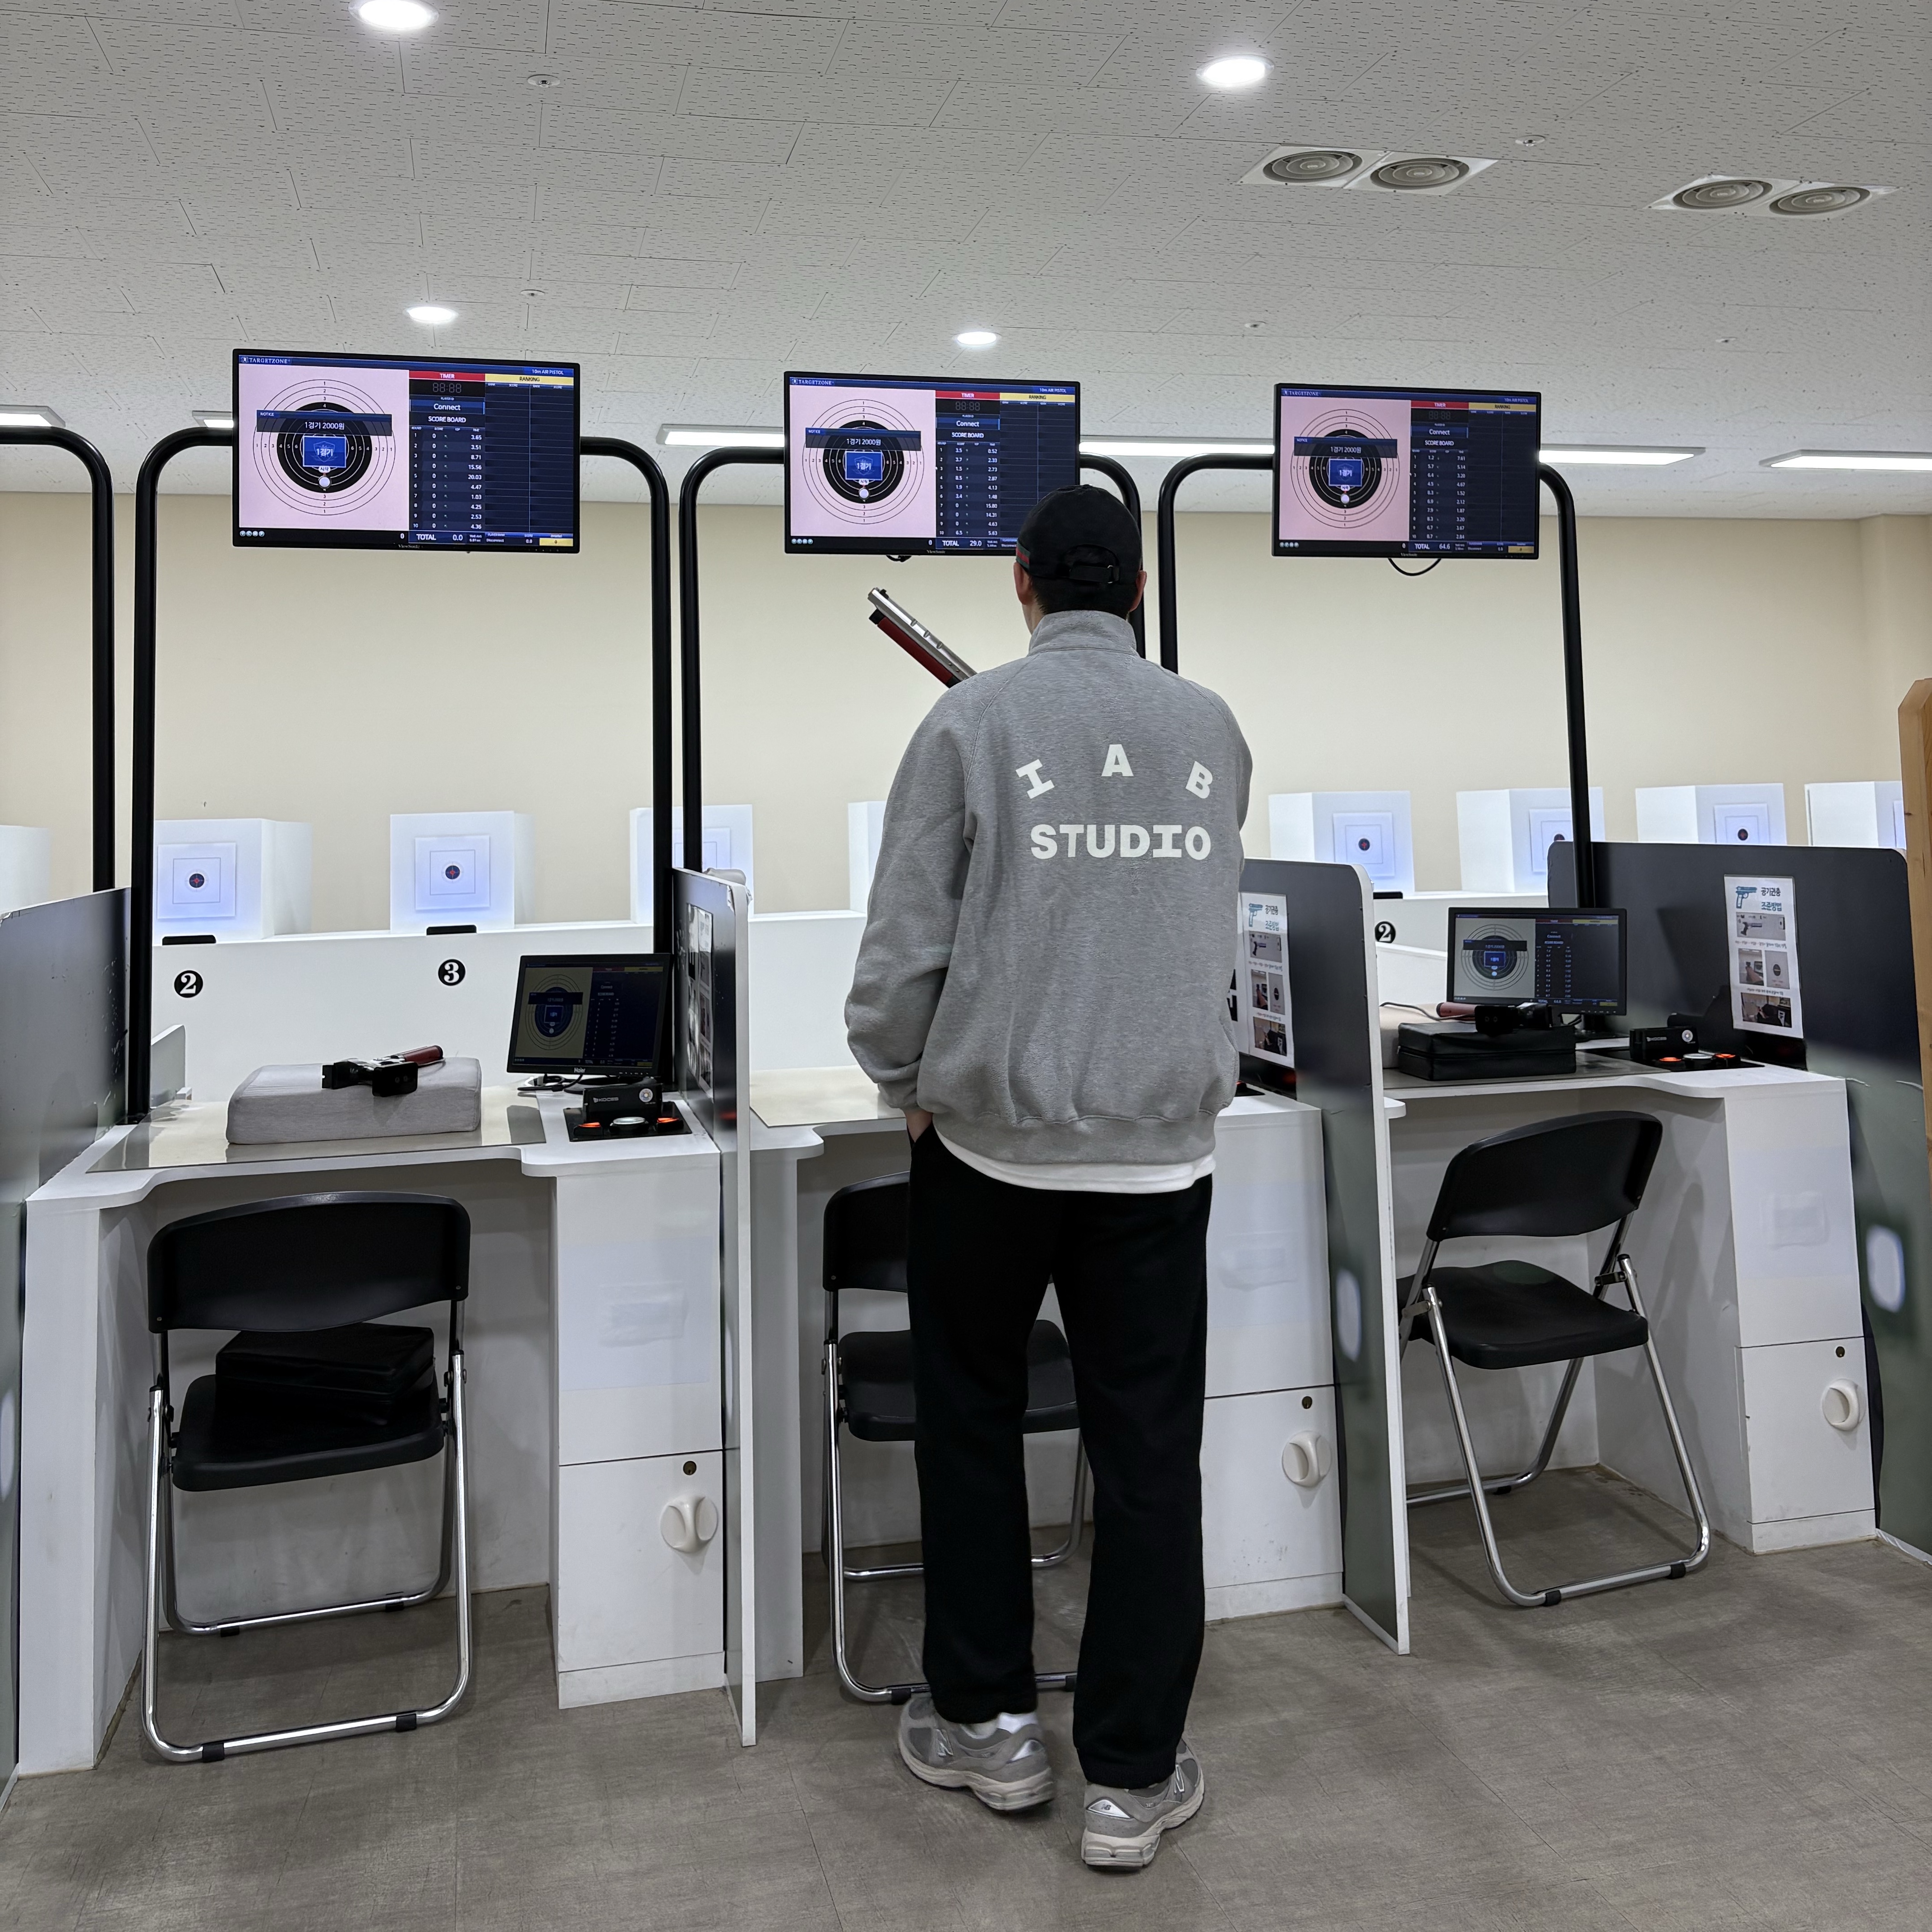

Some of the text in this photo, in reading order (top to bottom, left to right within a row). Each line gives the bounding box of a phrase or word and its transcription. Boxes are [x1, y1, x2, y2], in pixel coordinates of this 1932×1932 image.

[316, 448, 333, 456] 1경기
[1030, 824, 1211, 860] STUDIO
[1761, 887, 1781, 897] 공기권총
[1761, 902, 1782, 911] 조준방법
[1379, 924, 1391, 941] 2
[443, 962, 460, 983] 3
[180, 973, 197, 994] 2
